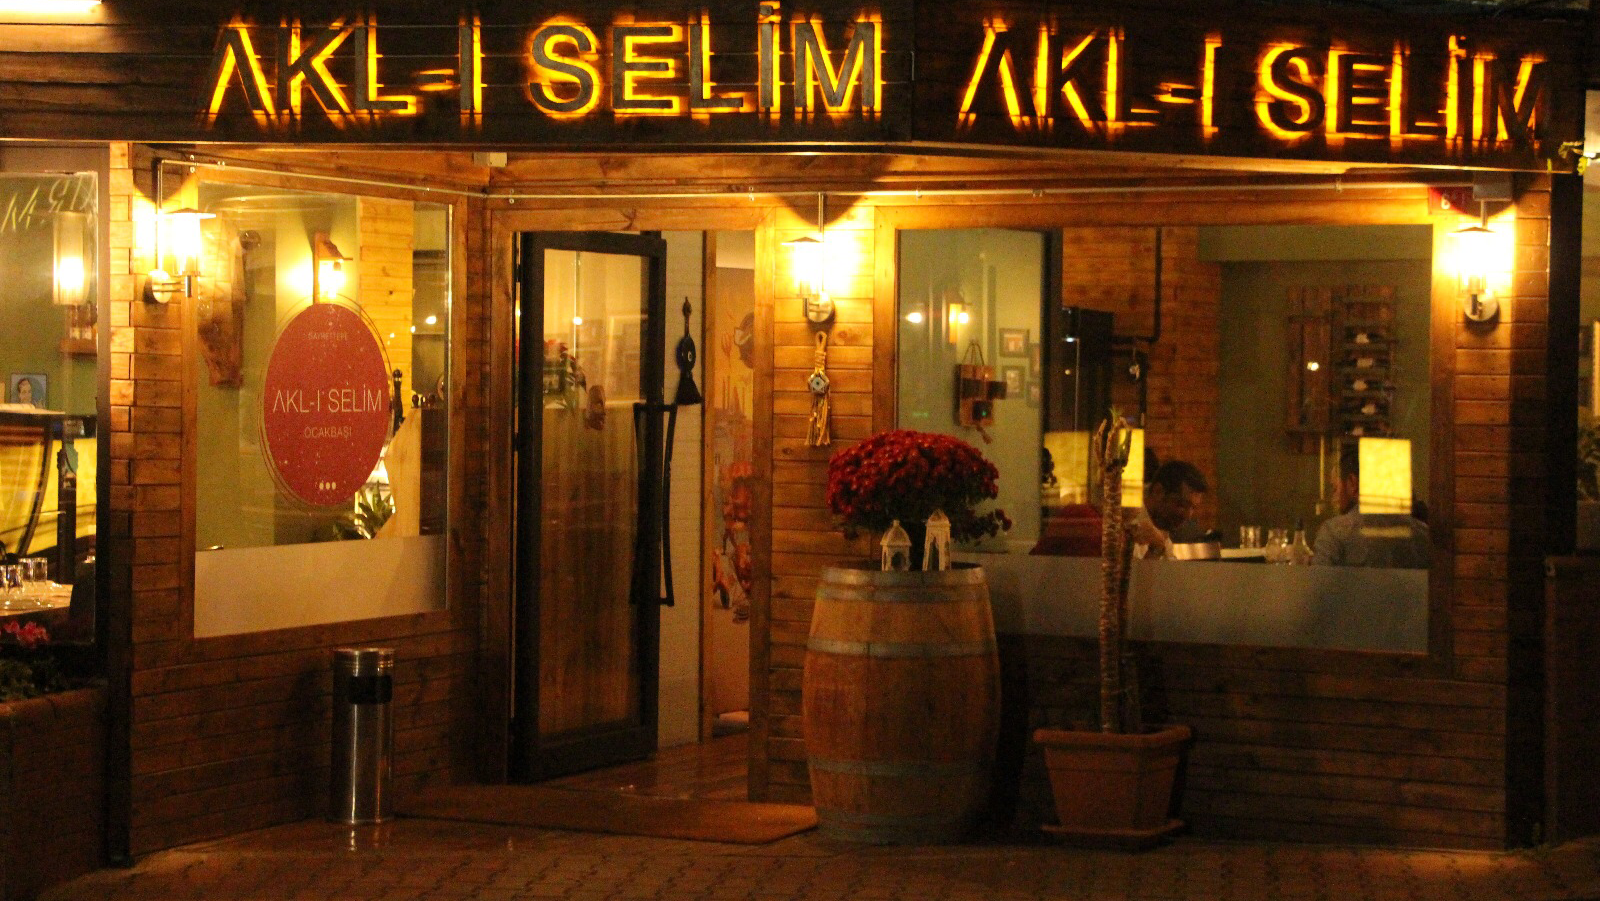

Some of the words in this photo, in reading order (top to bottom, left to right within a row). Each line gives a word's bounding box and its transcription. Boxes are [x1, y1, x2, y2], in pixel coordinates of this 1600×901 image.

[527, 2, 883, 114] SELİM
[1253, 36, 1546, 142] SELİM
[328, 383, 382, 413] SELİM
